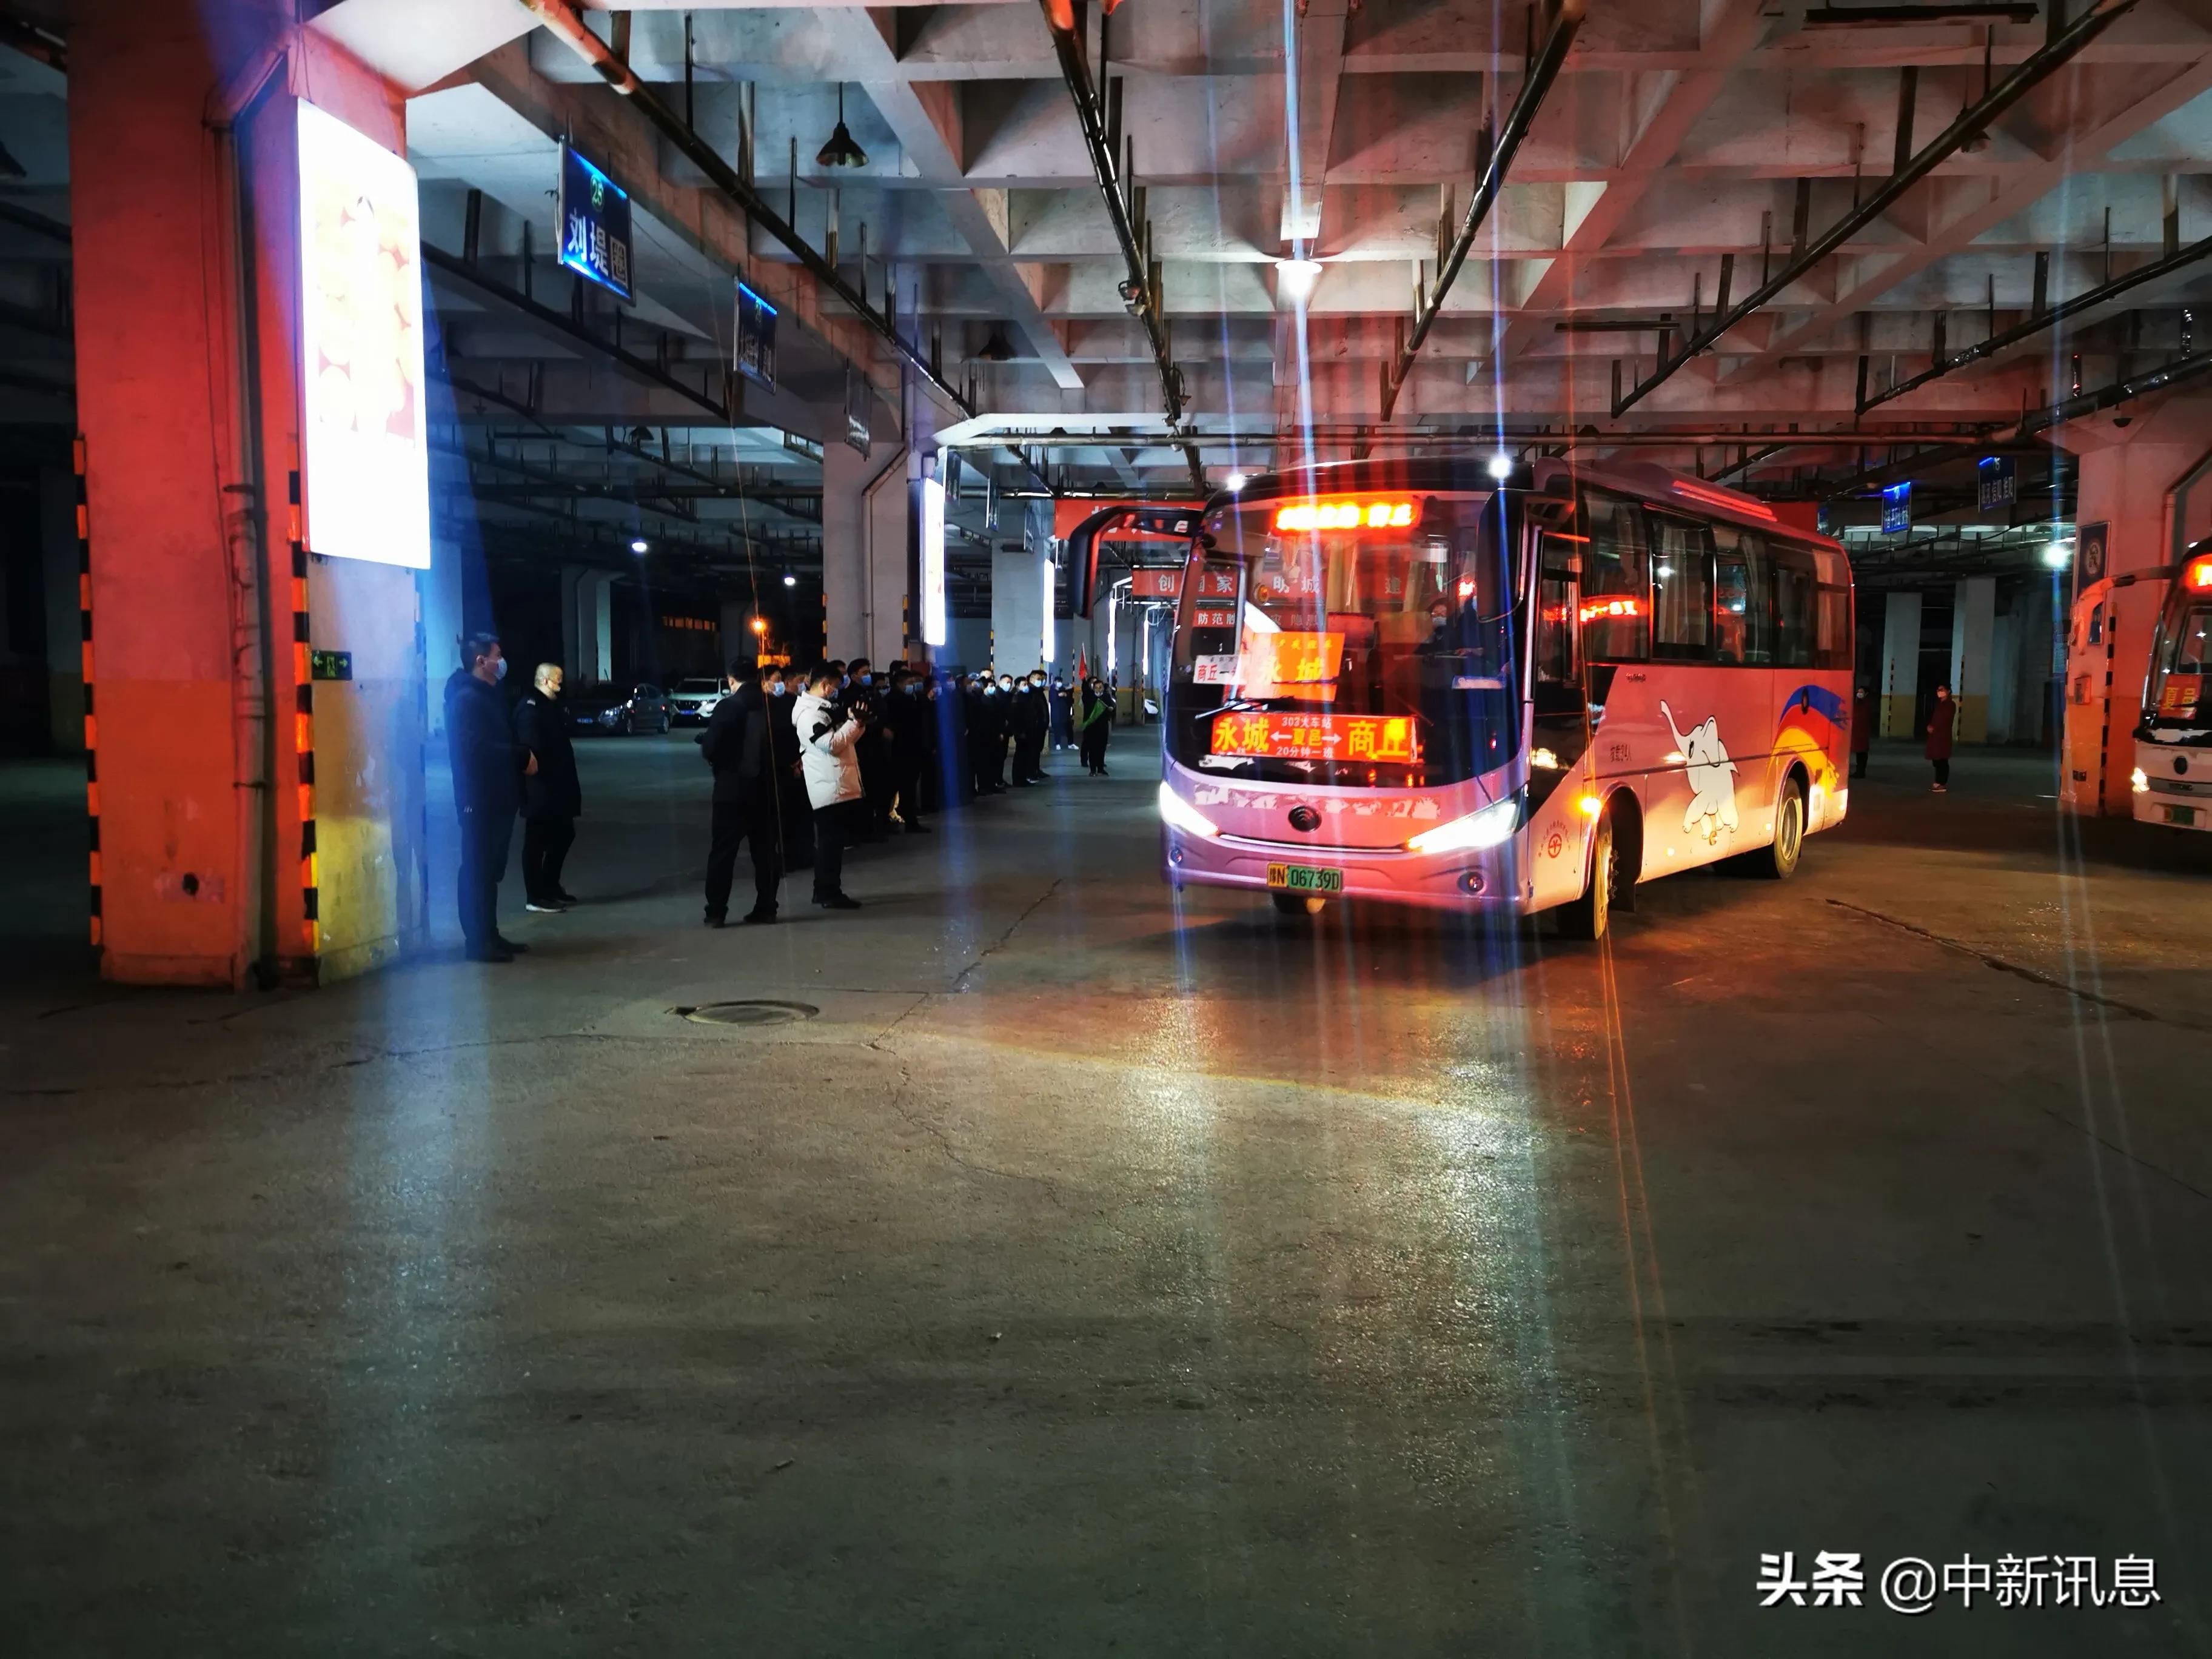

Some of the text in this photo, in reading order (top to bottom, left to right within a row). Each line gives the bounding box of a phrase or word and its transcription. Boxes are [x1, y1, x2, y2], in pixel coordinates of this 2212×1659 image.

[568, 207, 628, 289] 刘堤圈
[1214, 717, 1270, 752] 永城
[1292, 727, 1322, 746] 夏邑
[1281, 716, 1332, 729] 303火车站
